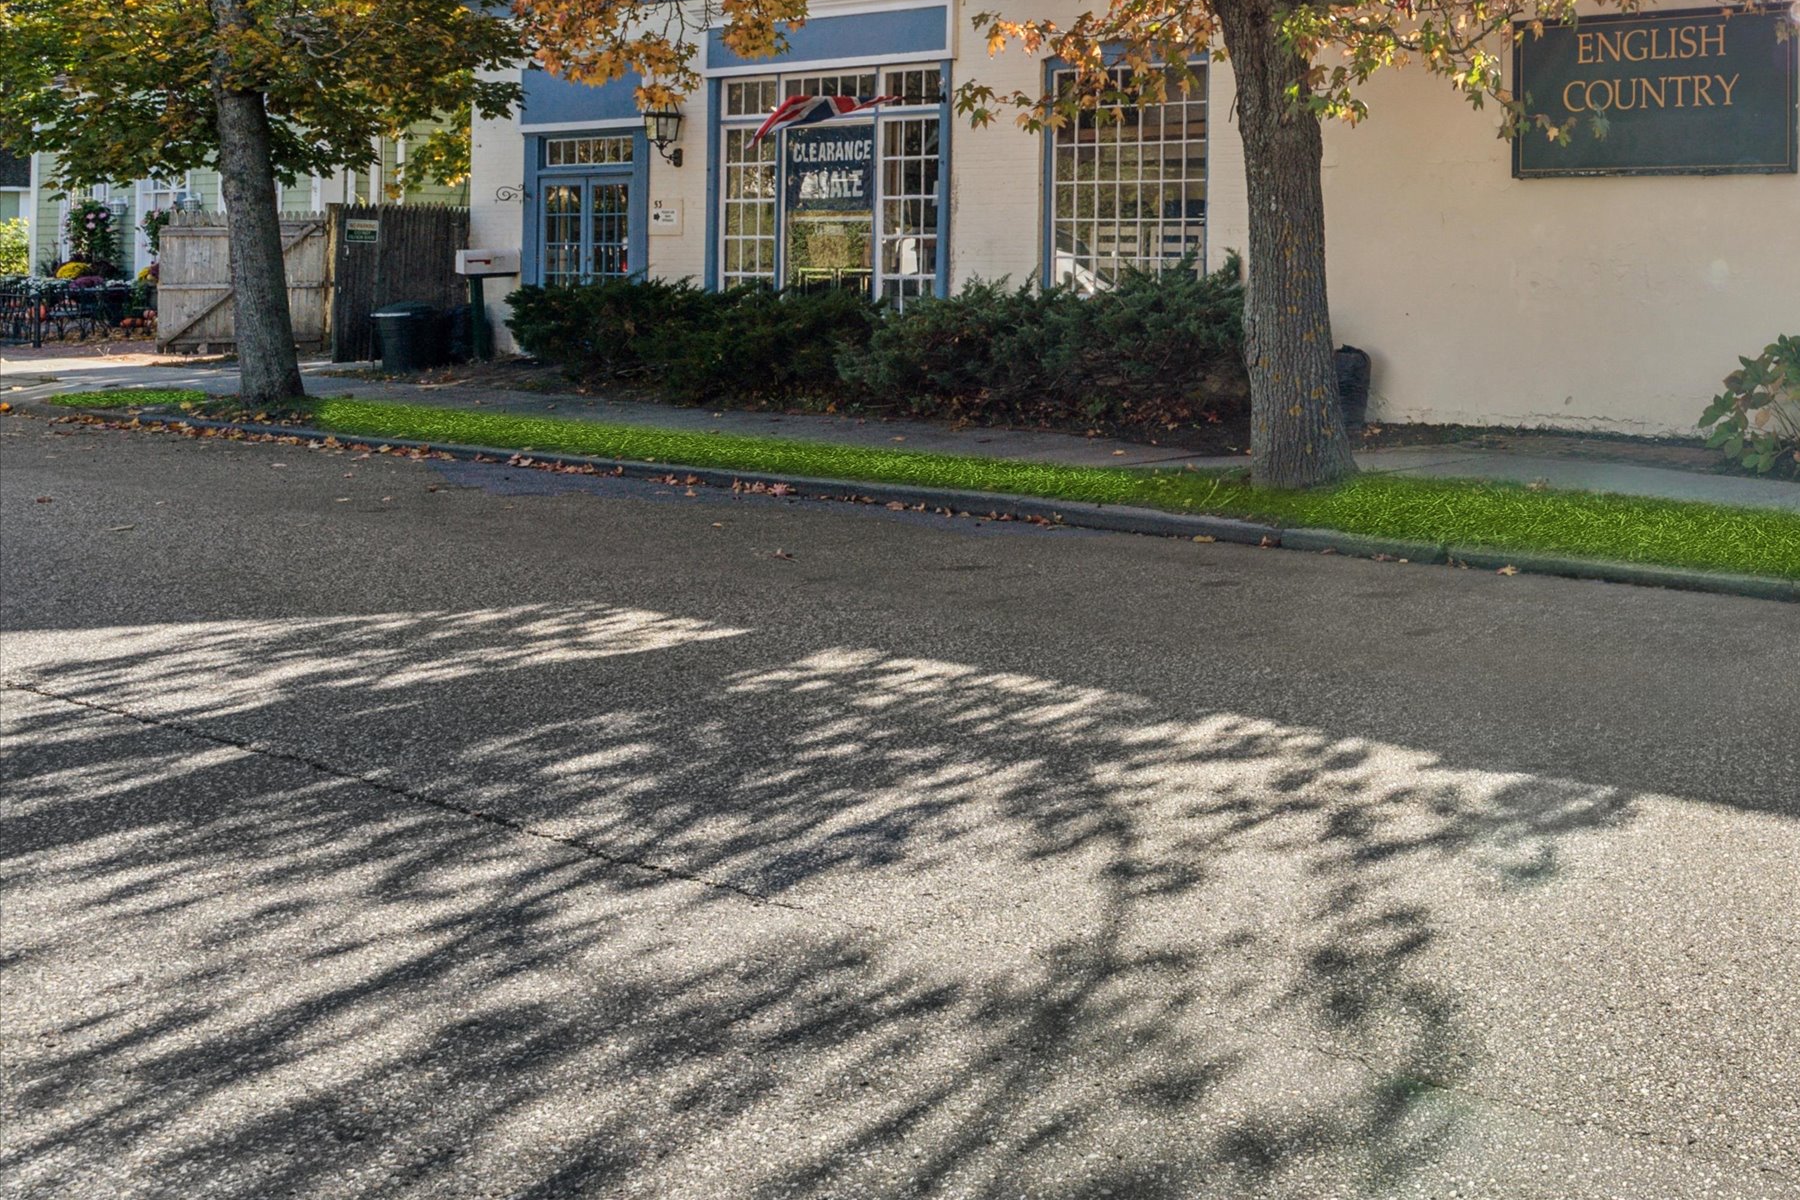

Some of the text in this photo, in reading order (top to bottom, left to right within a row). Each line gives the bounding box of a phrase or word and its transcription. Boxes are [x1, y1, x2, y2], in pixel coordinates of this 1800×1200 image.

[1576, 24, 1727, 64] ENGLISH
[1562, 73, 1740, 112] COUNTRY
[792, 140, 873, 163] CLEARANCE
